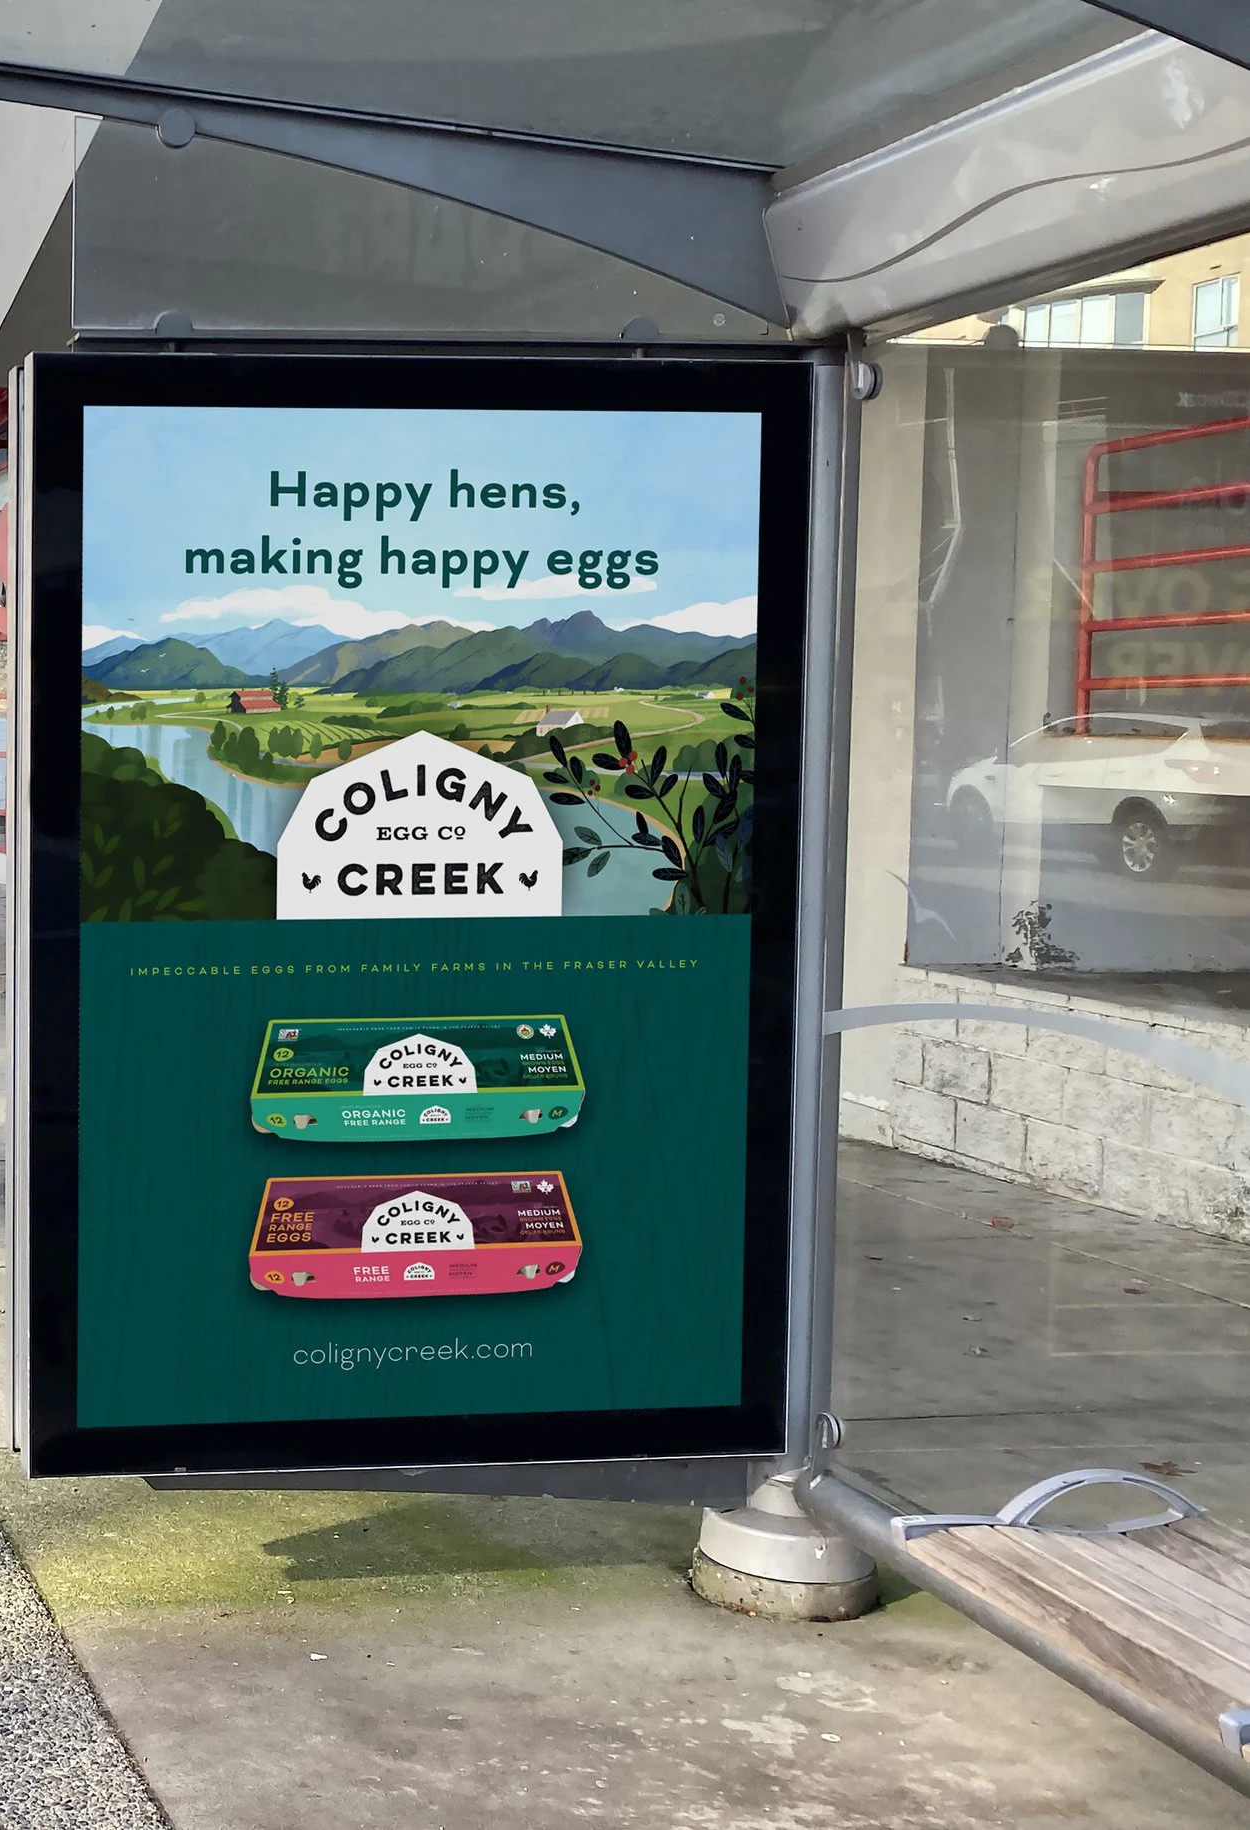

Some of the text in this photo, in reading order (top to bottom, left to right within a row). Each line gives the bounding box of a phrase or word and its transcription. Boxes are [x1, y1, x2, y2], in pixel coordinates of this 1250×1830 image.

[270, 468, 581, 522] Happy hens,
[184, 535, 660, 590] making happy eggs
[315, 764, 534, 842] COLIGNY
[376, 826, 428, 841] EGG
[337, 862, 504, 896] CREEK
[130, 959, 699, 977] IMPECCABLE EGGS FROM FAMILY FARMS IN THE FRASER VALLEY
[277, 1050, 289, 1058] 12
[379, 1043, 463, 1070] COLIGNY
[519, 1053, 564, 1061] MEDIUM
[269, 1066, 349, 1078] ORGANIC
[387, 1075, 454, 1088] CREEK
[341, 1108, 407, 1119] ORGANIC
[269, 1116, 284, 1125] 12
[344, 1118, 407, 1127] FREE RANGE
[276, 1200, 289, 1209] 12
[270, 1211, 314, 1222] FREE
[377, 1200, 461, 1227] COLIGNY
[517, 1209, 561, 1217] MEDIUM
[268, 1223, 313, 1231] RANGE
[525, 1221, 564, 1229] MOYEN
[266, 1232, 312, 1243] EGGS
[385, 1231, 451, 1245] CREEK
[353, 1266, 390, 1275] FREE
[268, 1273, 282, 1281] 12
[355, 1275, 390, 1283] RANGE
[293, 1337, 533, 1371] colignycreek.com
